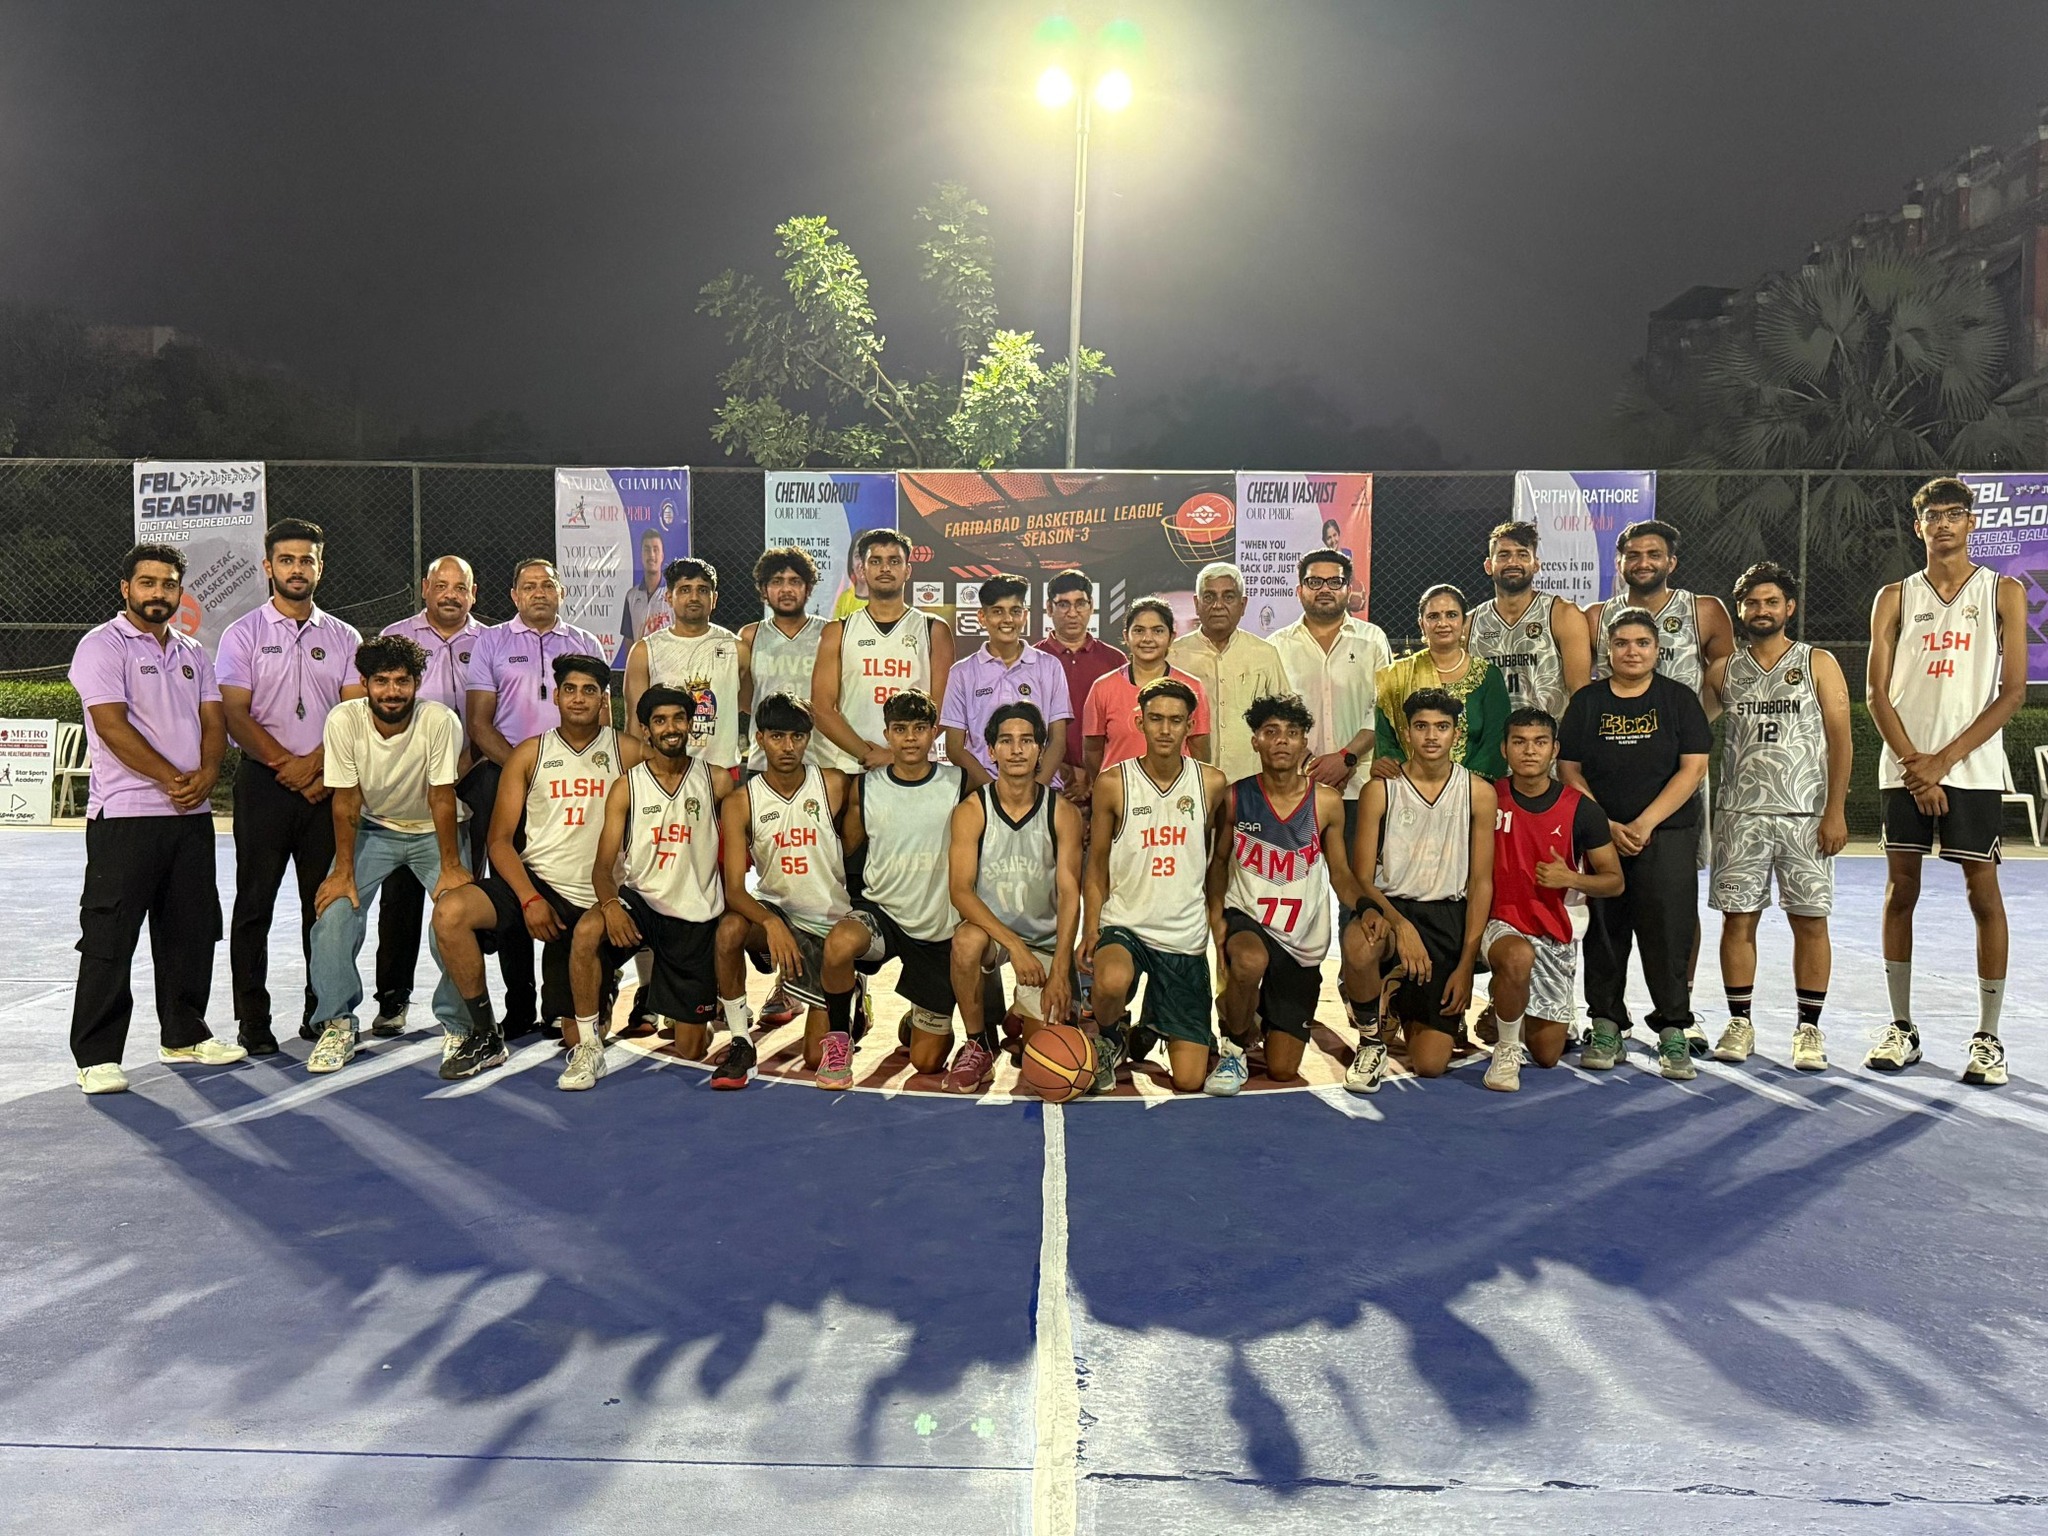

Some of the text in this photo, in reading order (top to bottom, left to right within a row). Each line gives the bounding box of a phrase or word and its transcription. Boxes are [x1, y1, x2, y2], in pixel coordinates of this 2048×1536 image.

[139, 472, 181, 494] FBL
[618, 477, 681, 491] CHAUHAN
[775, 481, 860, 504] CHETNA SOROUT
[1247, 481, 1337, 504] CHEENA VASHIST
[141, 491, 255, 519] SEASON-3
[1582, 488, 1639, 504] RATHORE
[593, 505, 619, 521] OUR
[774, 507, 821, 520] OUR PRIDE
[944, 502, 1164, 539] FARIDABAD BASKETBALL LEAGUE
[1246, 507, 1295, 520] OUR PRIDE
[1971, 504, 2048, 529] SEASO
[139, 515, 253, 532] DIGITAL SCOREBOARD
[1553, 515, 1579, 532] OUR
[140, 531, 190, 543] PARTNER
[778, 537, 795, 546] FIND
[796, 537, 815, 546] THAT
[816, 537, 830, 546] THE
[1022, 527, 1090, 548] SEASON-3
[1269, 540, 1286, 549] YOU
[2018, 528, 2048, 542] BALL
[1240, 552, 1301, 562] FALL, GET RIGHT
[1570, 558, 1578, 571] is
[1581, 561, 1594, 571] no
[189, 550, 235, 591] TRIPLE-TAC
[1241, 564, 1295, 573] BACK UP. JUST
[197, 557, 249, 602] BASKETBALL
[204, 564, 258, 612] FOUNDATION
[1243, 576, 1288, 586] EEP GOING,
[1572, 578, 1580, 589] It
[1583, 577, 1591, 589] is
[592, 584, 617, 598] PLAY
[1245, 588, 1258, 597] EEP
[1260, 588, 1293, 597] PUSHING
[564, 604, 576, 617] AS
[1922, 630, 1971, 652] ILSH
[862, 658, 912, 678] ILSH
[1926, 659, 1955, 679] 44
[1507, 673, 1520, 693] 11
[1737, 699, 1801, 715] STUBBORN
[10, 730, 48, 738] METRO
[1757, 722, 1778, 743] 12
[29, 769, 48, 777] Sports
[549, 778, 605, 799] ILSH
[563, 807, 586, 826] 11
[651, 823, 692, 845] ILSH
[772, 827, 817, 849] ILSH
[1140, 825, 1187, 849] ILSH
[781, 856, 809, 875] 55
[1151, 857, 1176, 877] 23
[1257, 897, 1303, 933] 77
